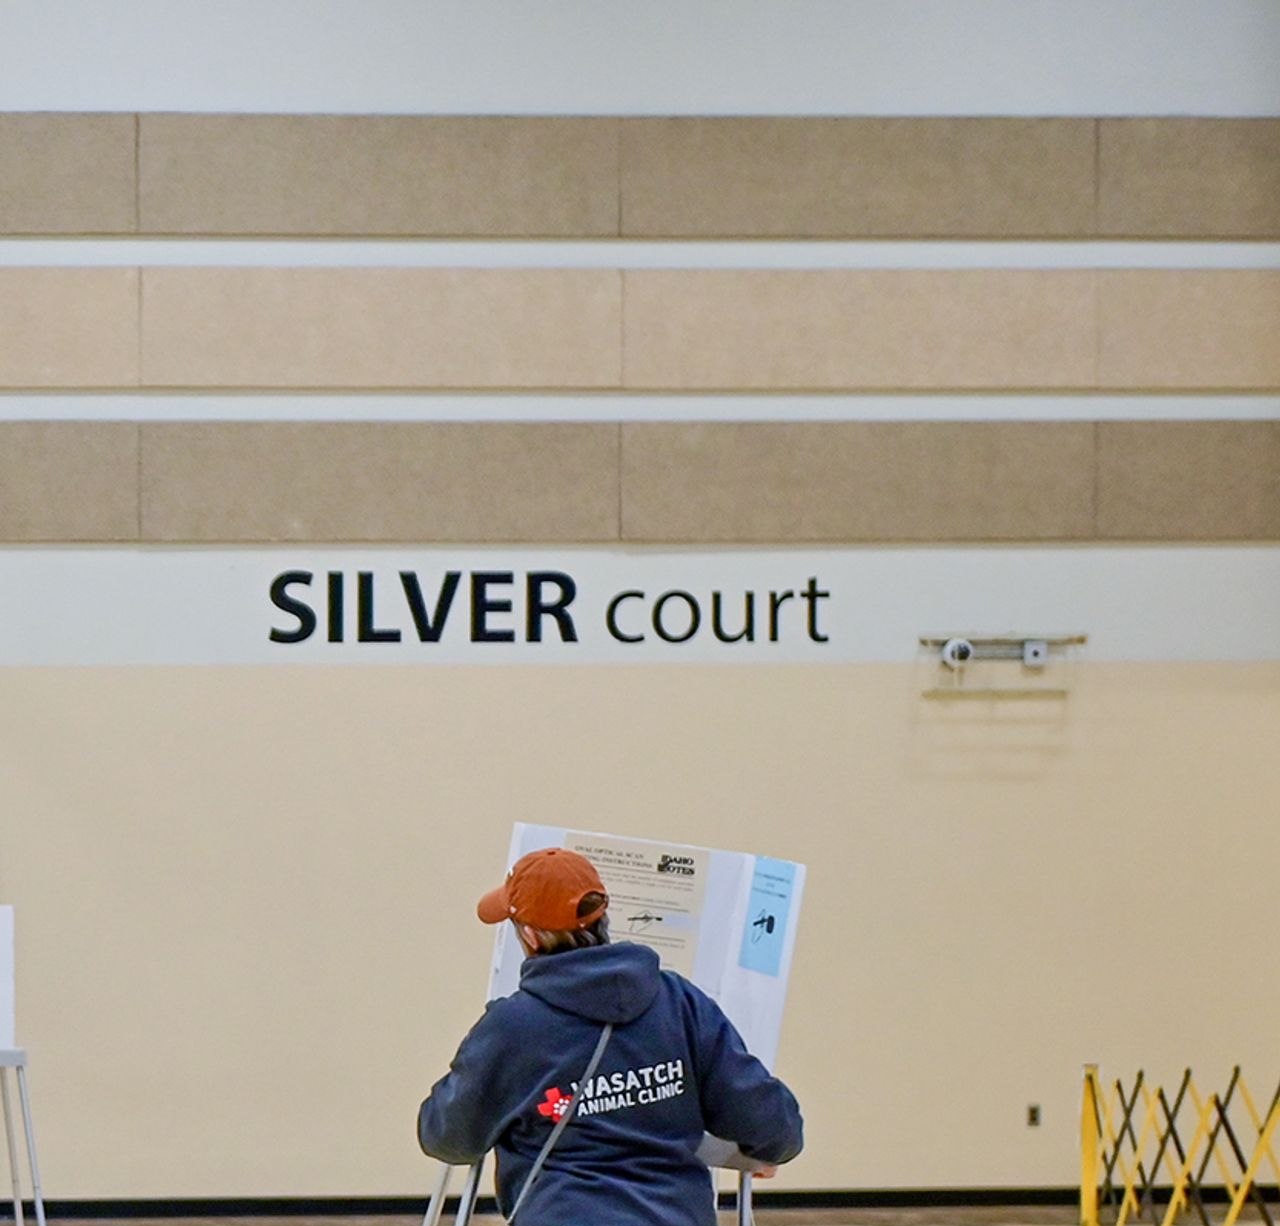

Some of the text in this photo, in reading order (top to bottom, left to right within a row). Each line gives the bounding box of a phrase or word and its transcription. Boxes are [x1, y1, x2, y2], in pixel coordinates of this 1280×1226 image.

[268, 570, 831, 644] SILVER court
[570, 1059, 684, 1101] WASATCH
[577, 1080, 684, 1117] ANIMAL CLINIC
